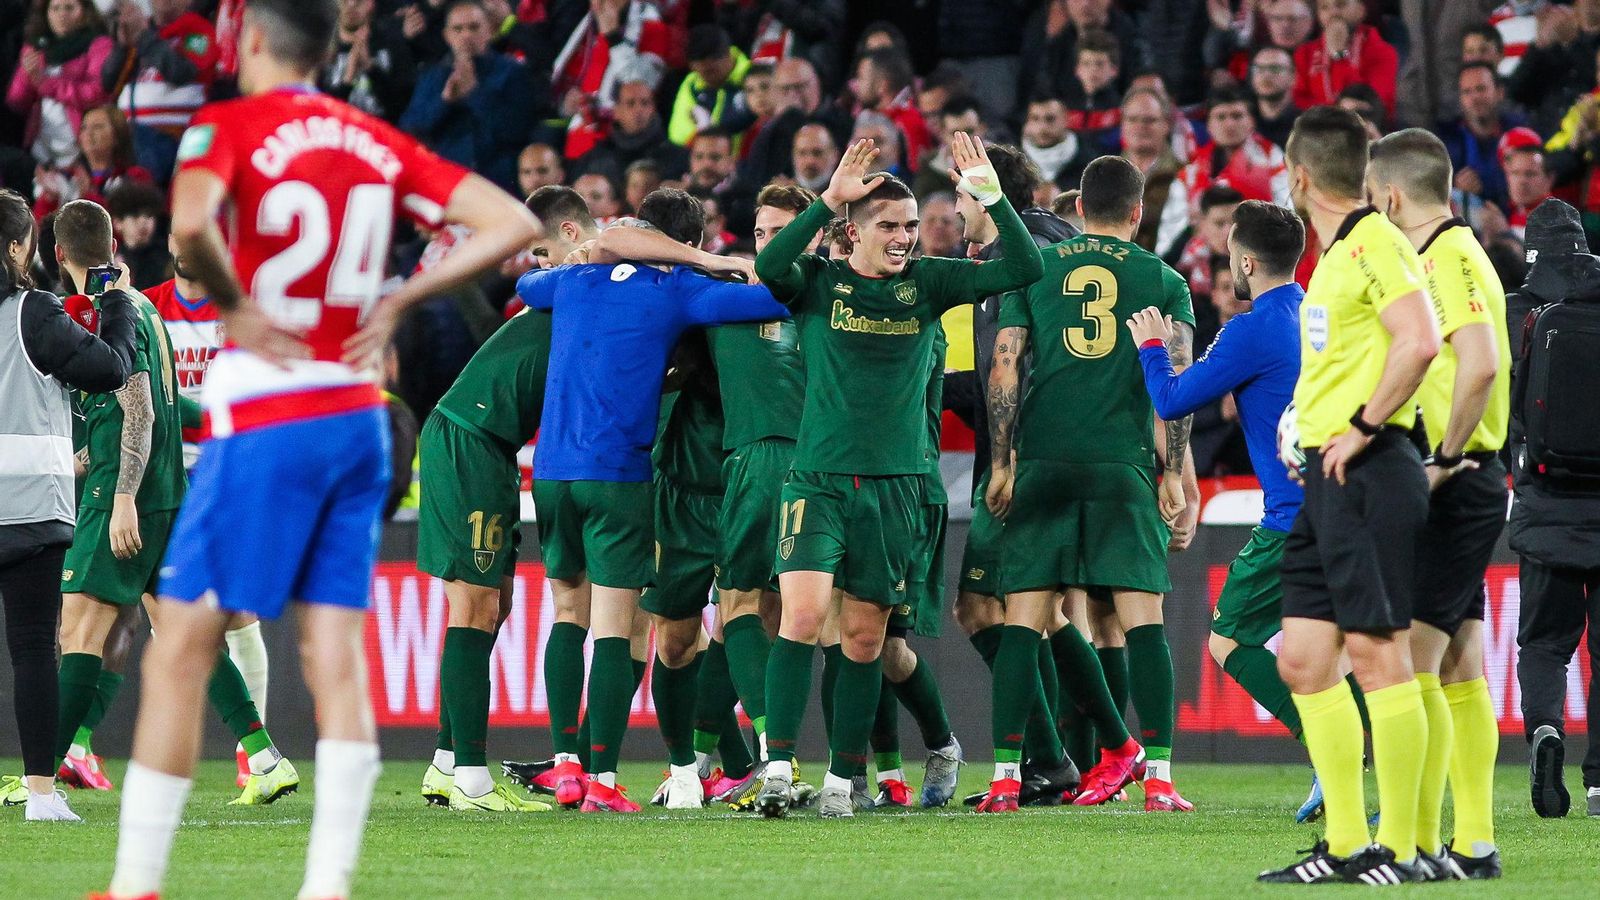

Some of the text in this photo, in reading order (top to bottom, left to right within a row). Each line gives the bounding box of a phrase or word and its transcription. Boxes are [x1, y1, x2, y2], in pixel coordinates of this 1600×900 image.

[251, 115, 343, 179] CARLOS
[250, 179, 395, 328] 24
[831, 299, 919, 335] Kutxabank
[1063, 264, 1118, 359] 3
[467, 510, 503, 551] 16
[780, 498, 806, 539] 11
